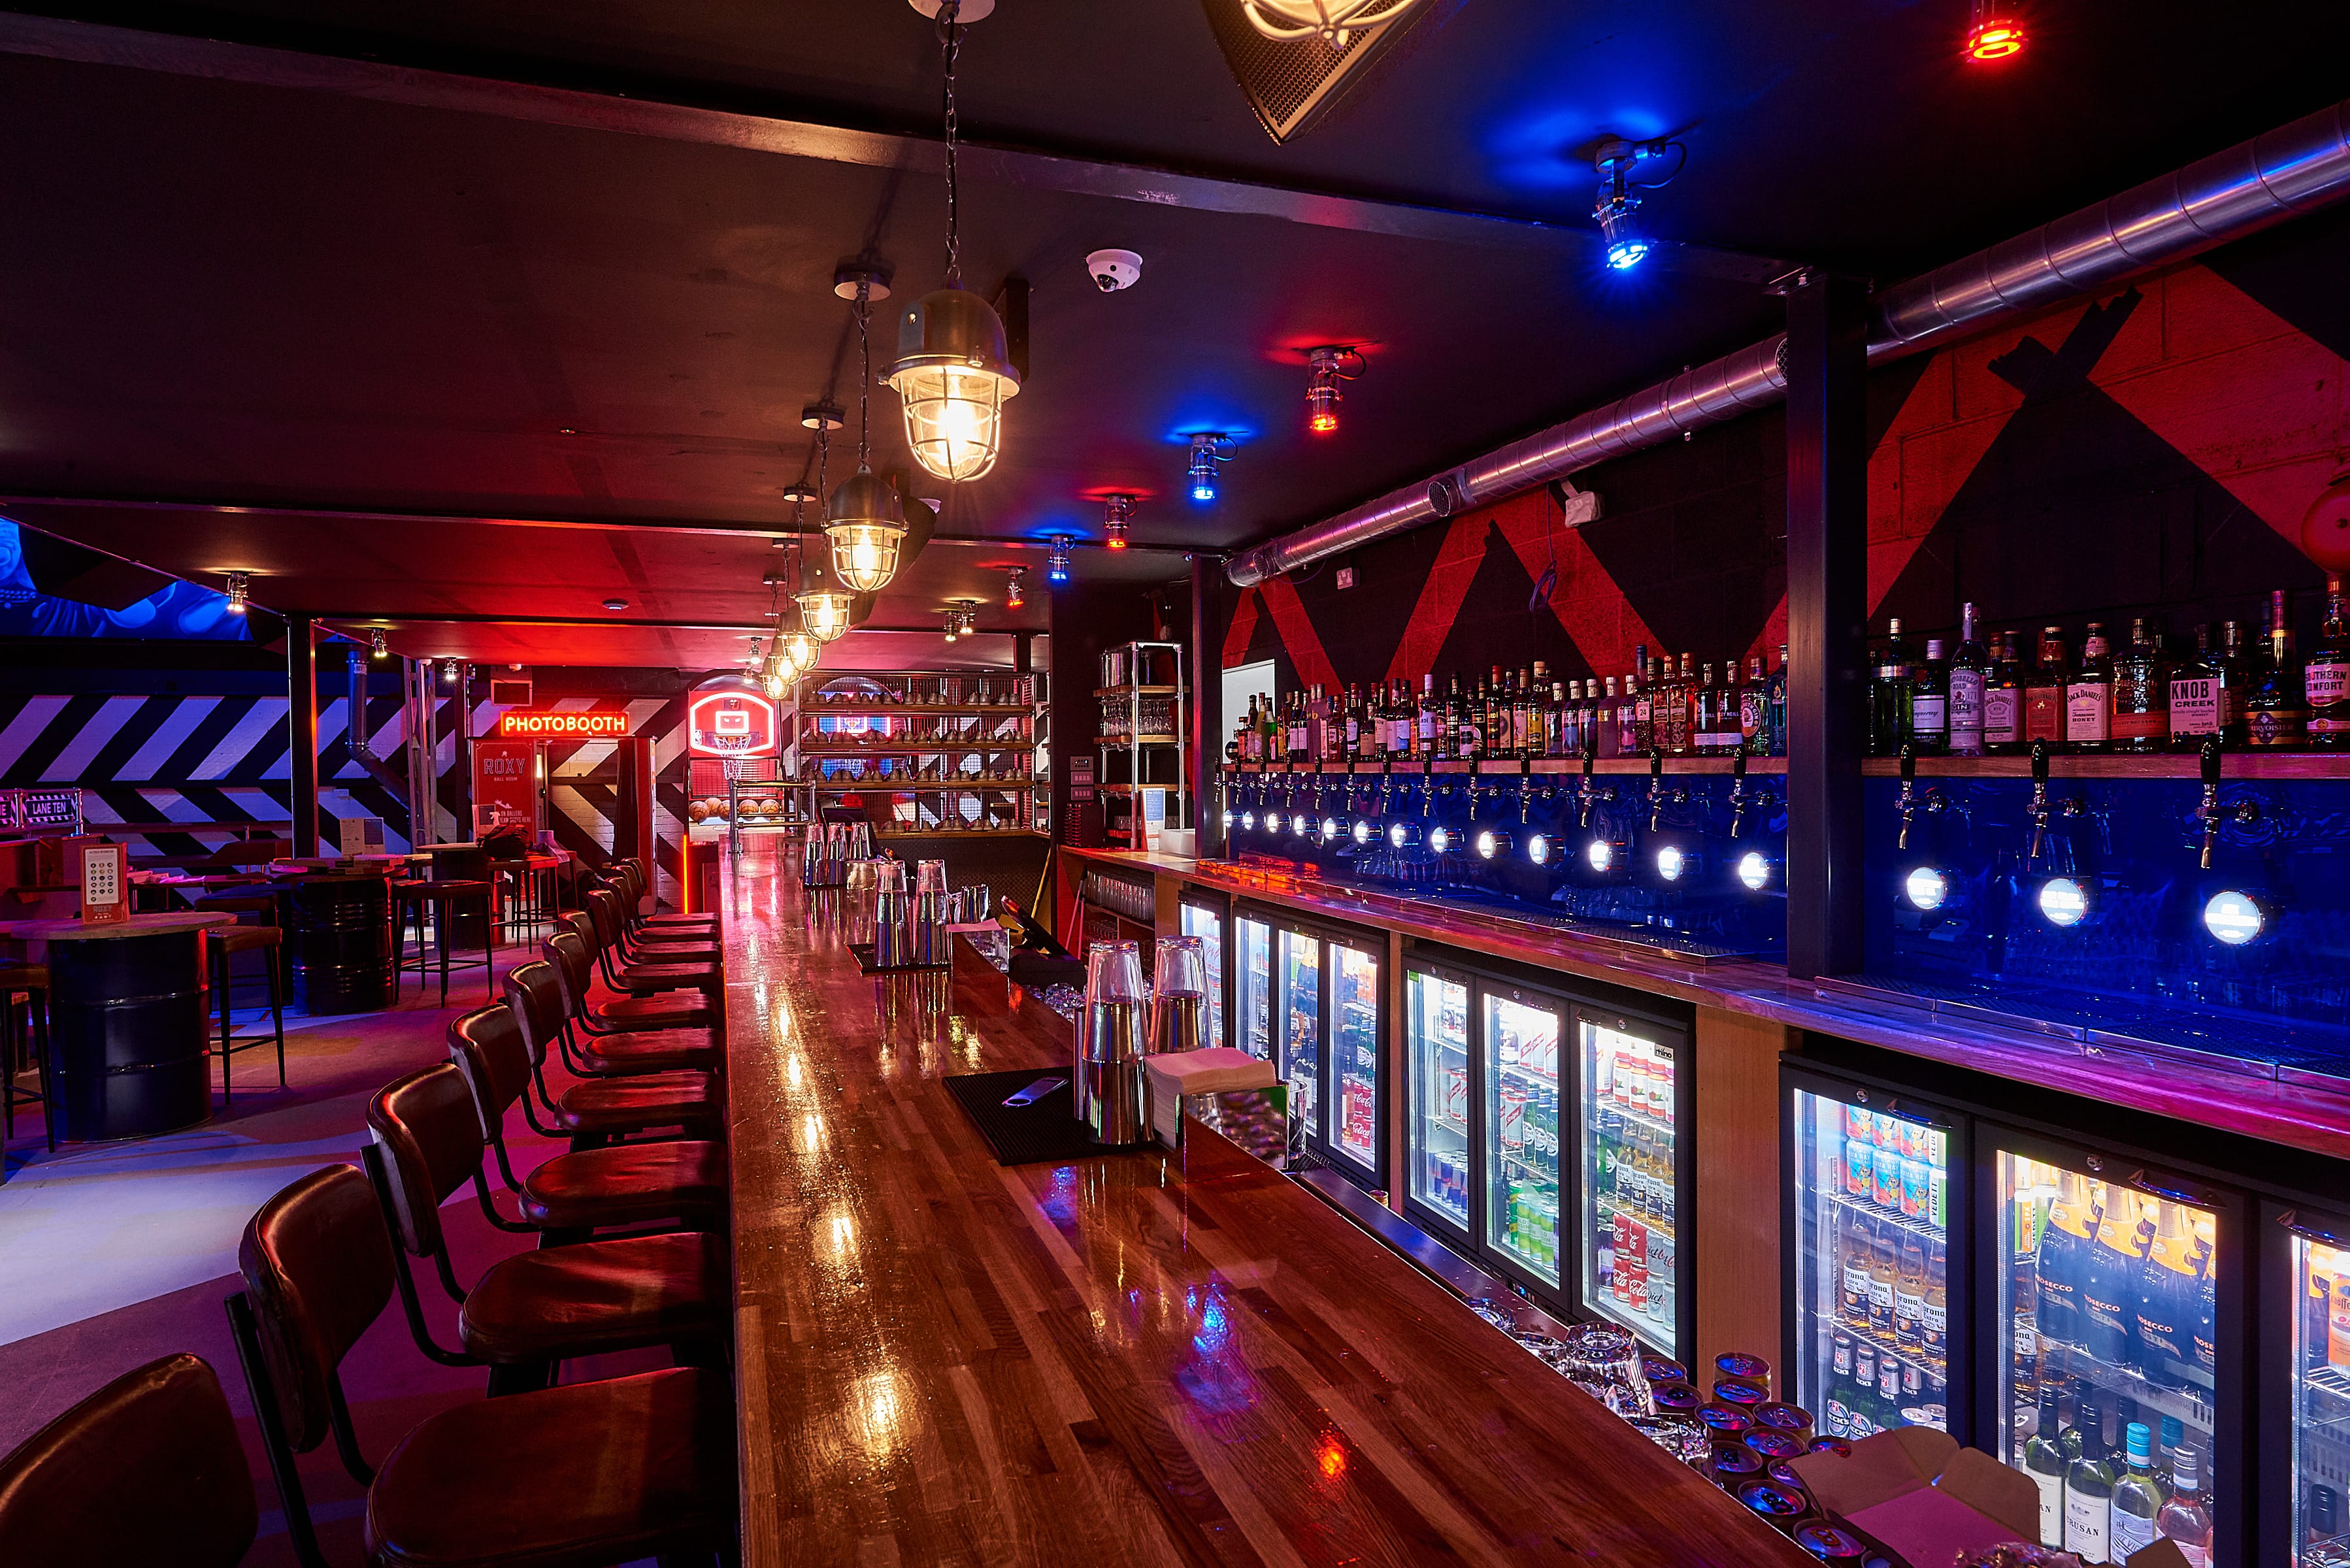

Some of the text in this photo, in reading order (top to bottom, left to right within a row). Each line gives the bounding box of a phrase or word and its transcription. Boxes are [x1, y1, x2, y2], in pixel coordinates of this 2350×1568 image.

[2306, 670, 2347, 681] SOUTHERN
[2172, 681, 2209, 700] KNOB
[2307, 681, 2343, 692] COMFORT
[2067, 689, 2103, 703] JACK DANIEL'S
[505, 716, 625, 731] PHOTOBOOTH
[484, 759, 525, 774] ROXY
[33, 802, 66, 815] LANE TEN
[1629, 1279, 1647, 1297] Cola
[1896, 1294, 1919, 1306] orona
[2040, 1289, 2063, 1302] OSTI
[1923, 1305, 1945, 1317] orona
[2089, 1309, 2111, 1322] OSTI
[2142, 1330, 2162, 1343] OSTI
